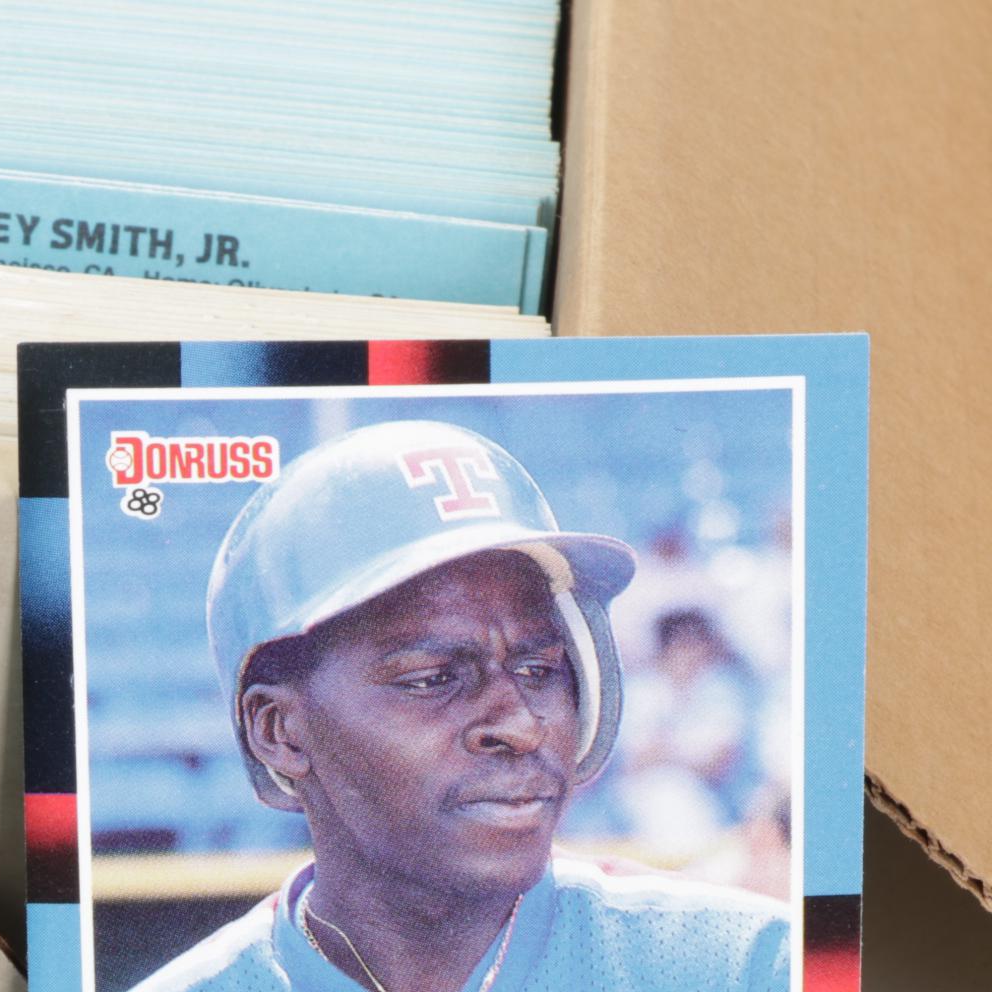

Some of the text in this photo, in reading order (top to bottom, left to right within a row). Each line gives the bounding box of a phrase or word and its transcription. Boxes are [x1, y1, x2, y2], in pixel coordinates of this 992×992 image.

[50, 218, 185, 267] SMITH,
[196, 233, 250, 268] JR.
[109, 436, 274, 485] DONRUSS
